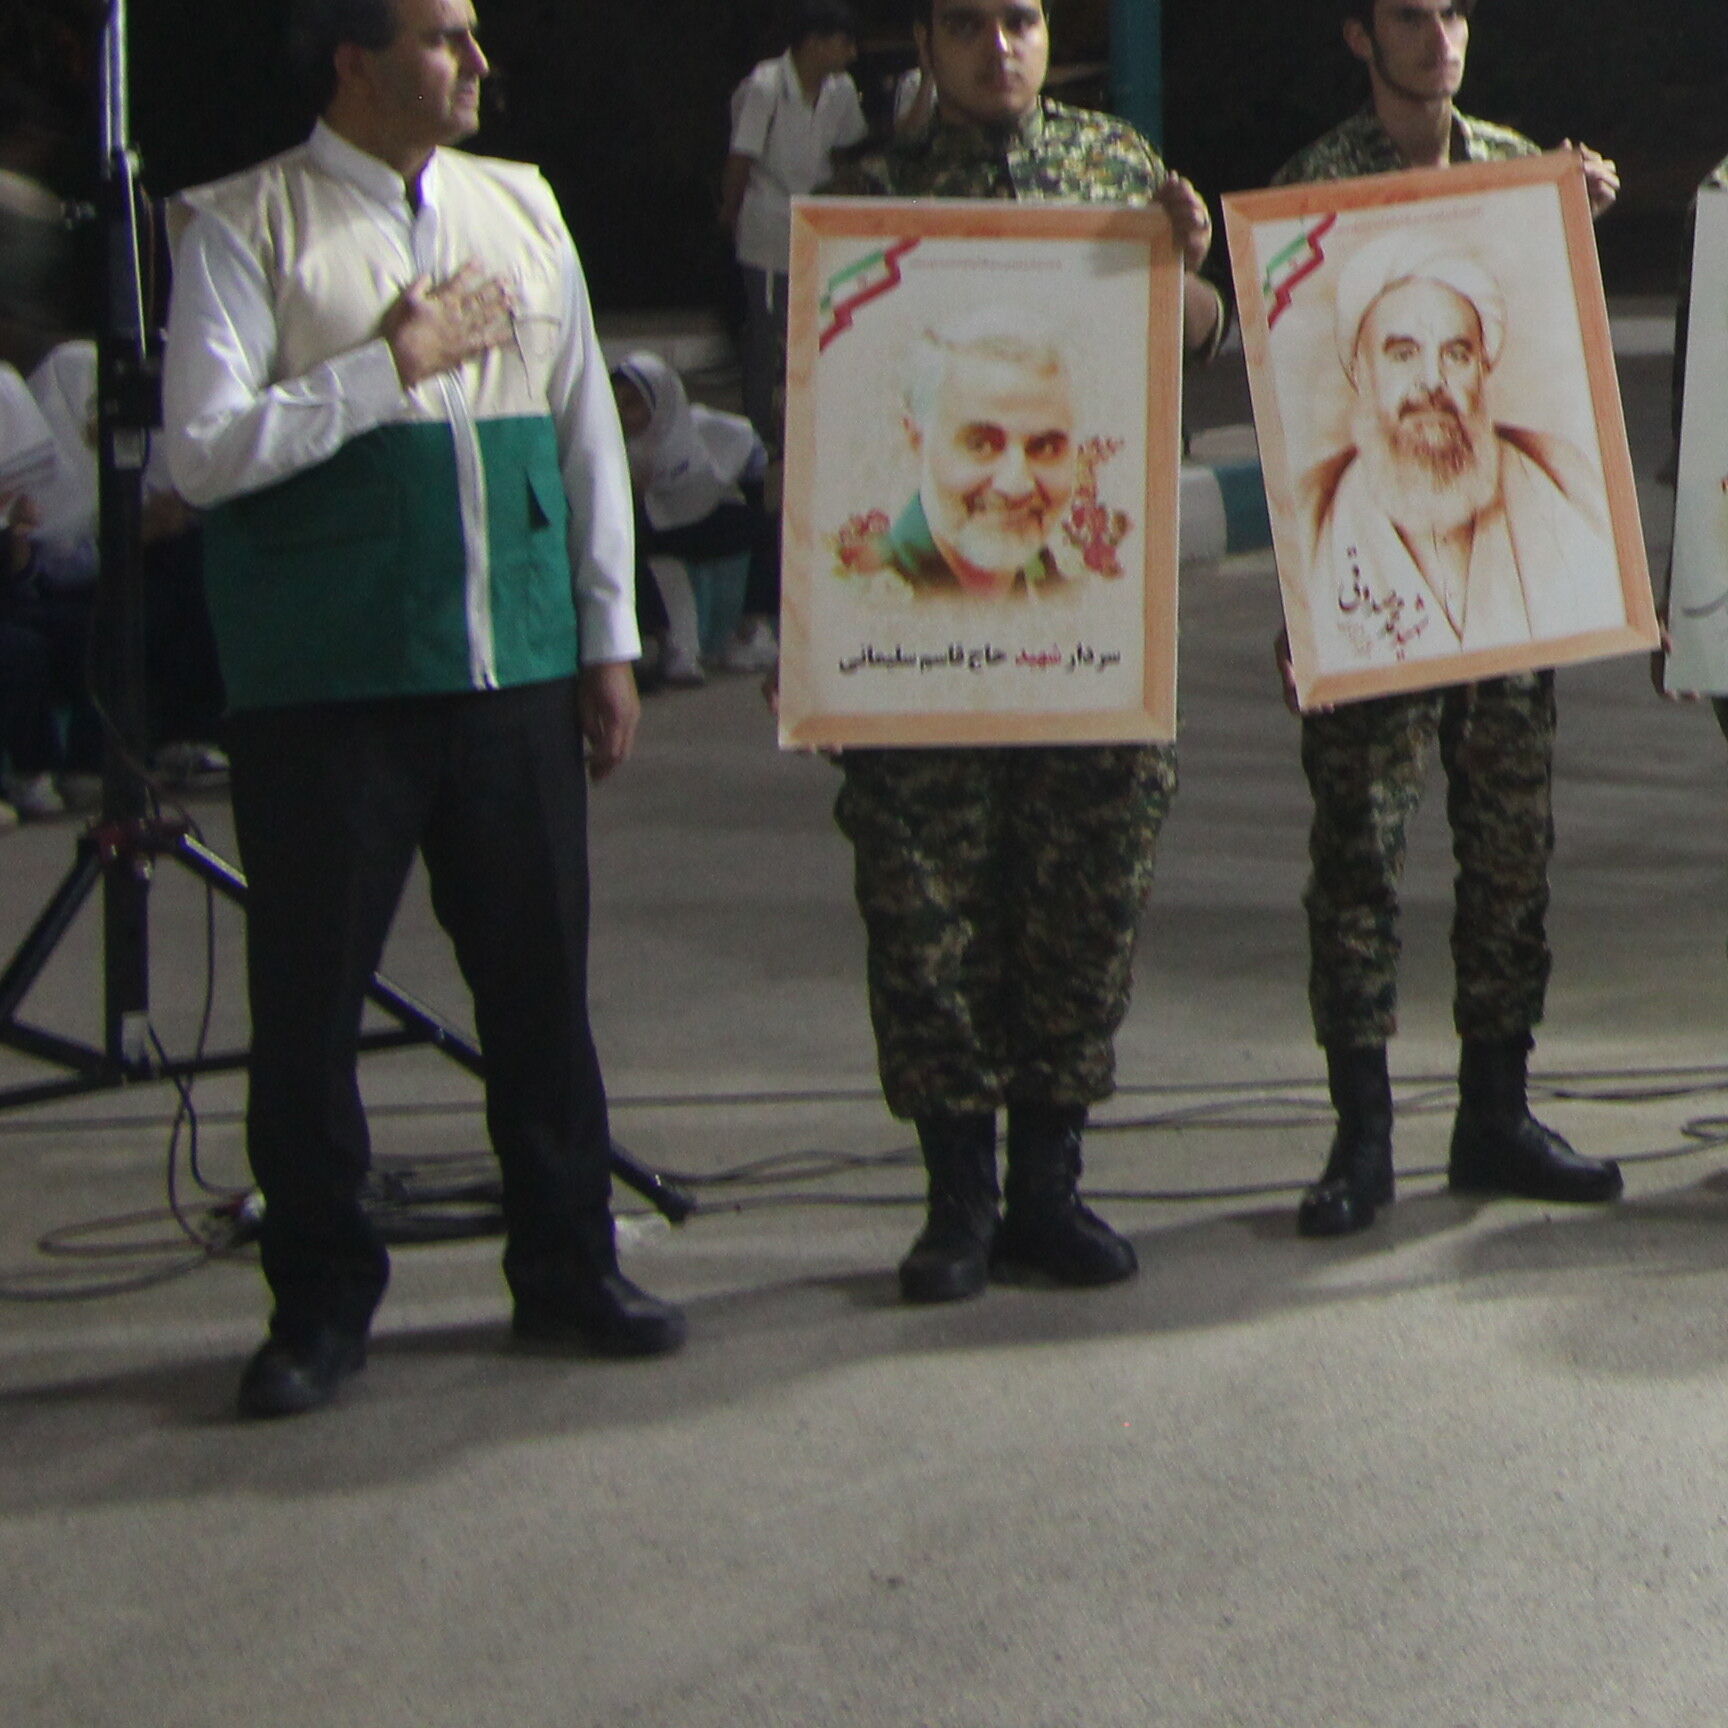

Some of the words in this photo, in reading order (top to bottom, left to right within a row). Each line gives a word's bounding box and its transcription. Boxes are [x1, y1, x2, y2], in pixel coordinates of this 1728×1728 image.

[838, 642, 917, 674] سلیمانی
[919, 641, 965, 673] قاسم
[967, 642, 1007, 670] حاج
[1014, 642, 1062, 672] شهید
[1067, 641, 1121, 672] سردار
